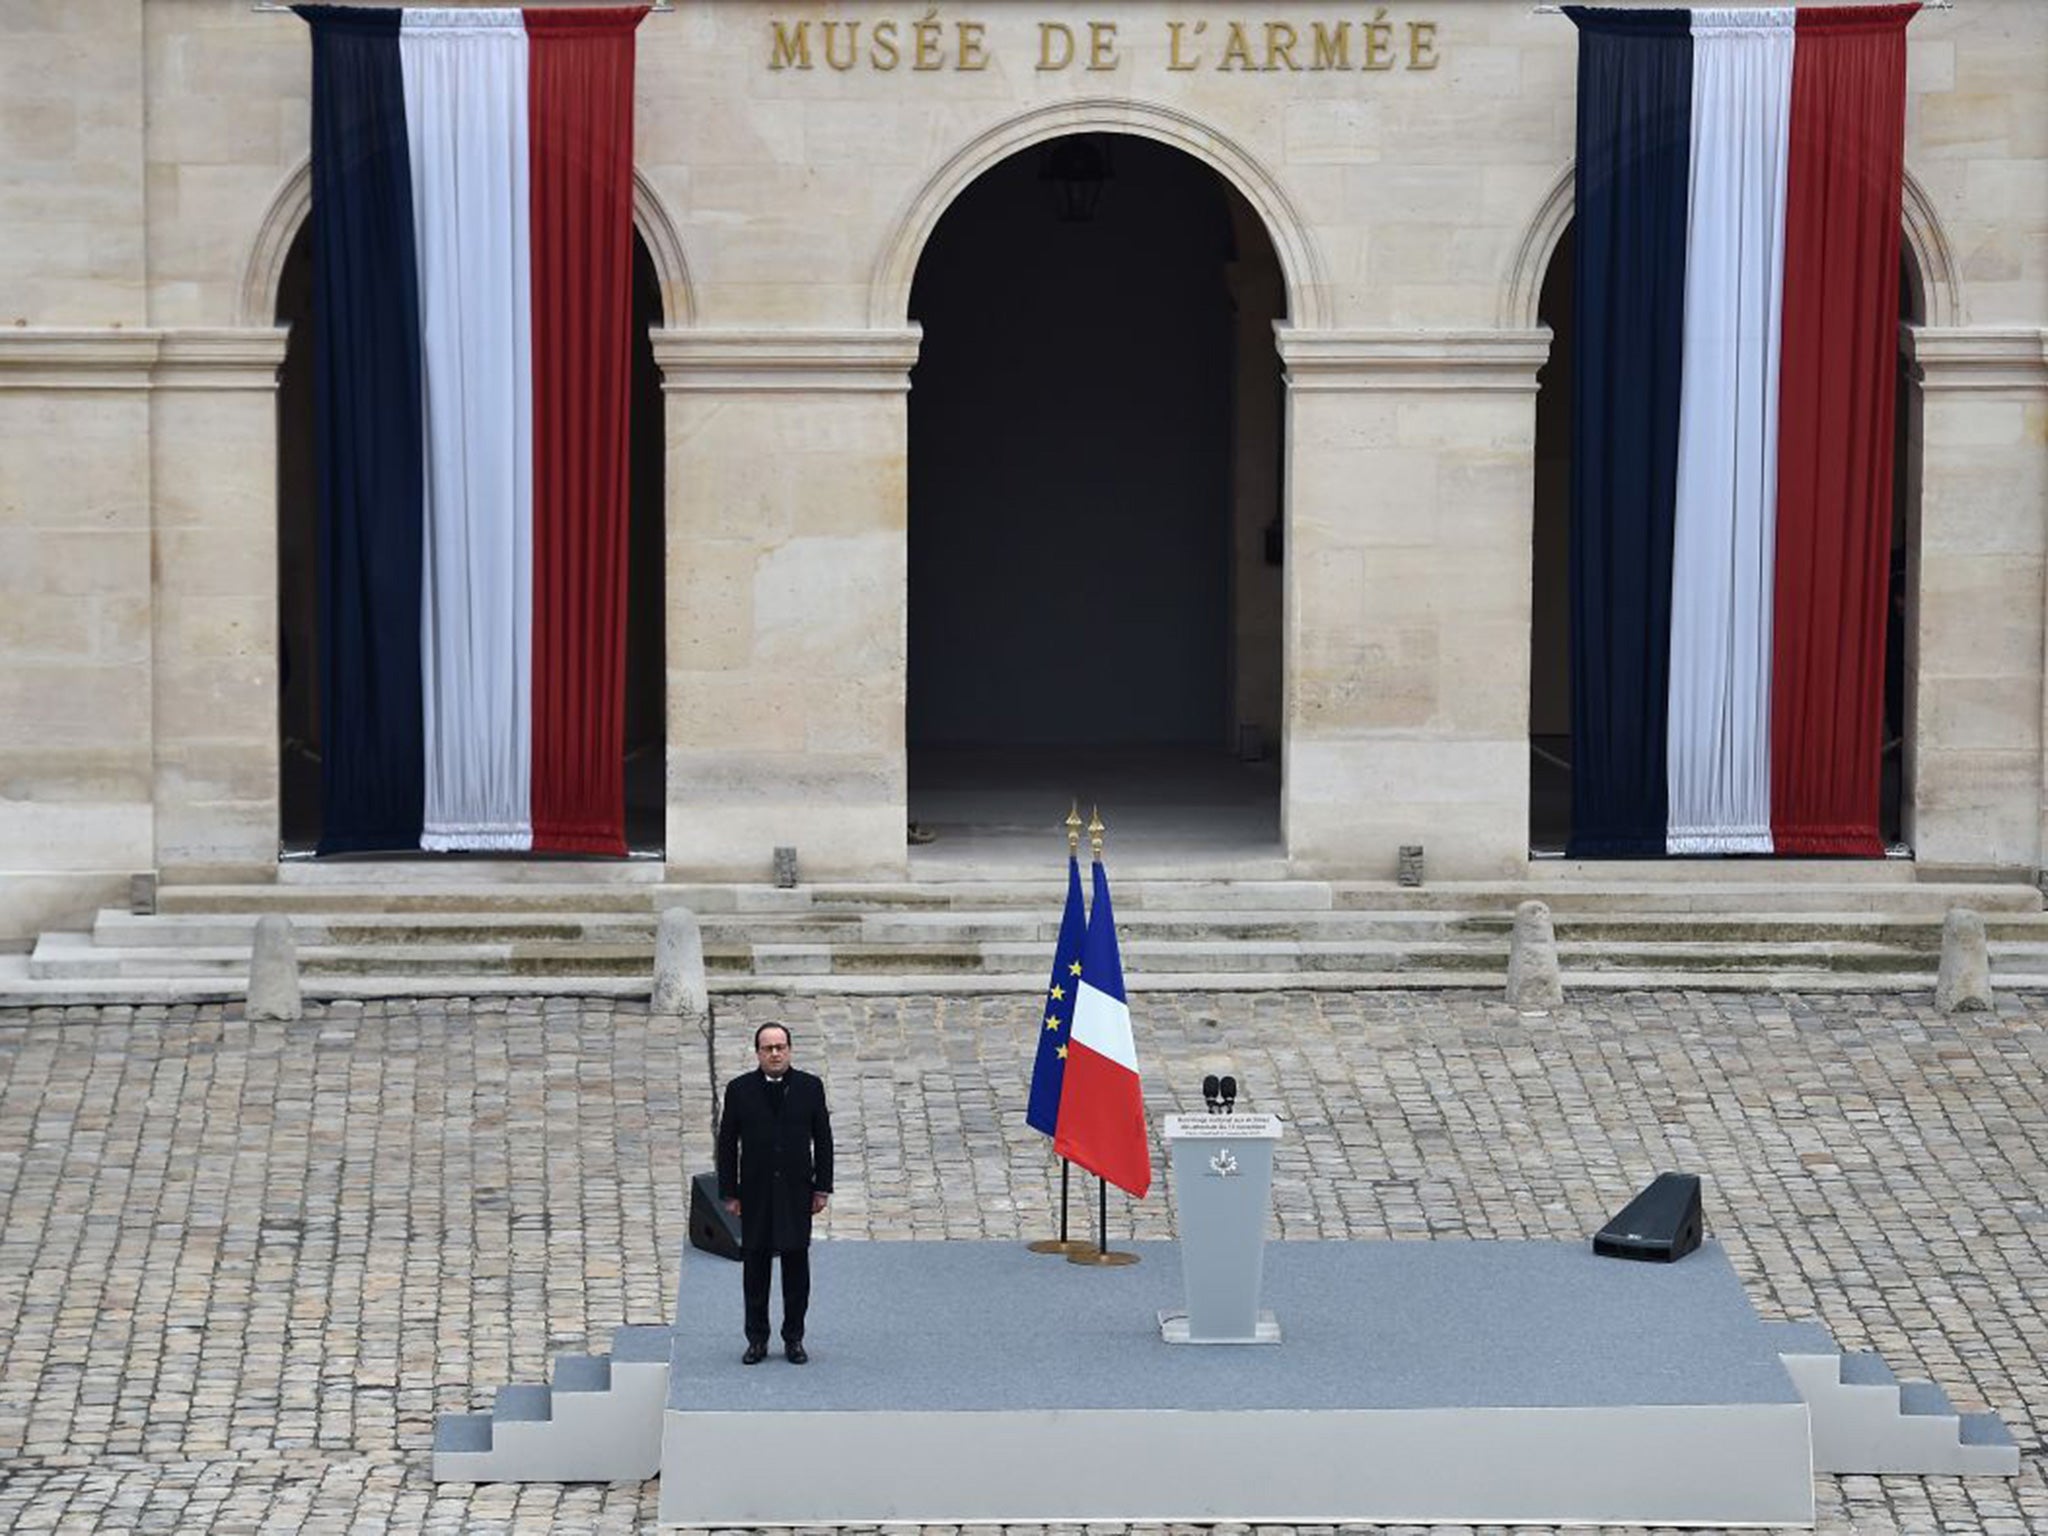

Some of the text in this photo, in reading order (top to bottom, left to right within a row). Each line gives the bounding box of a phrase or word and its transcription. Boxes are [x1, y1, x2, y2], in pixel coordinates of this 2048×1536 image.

[767, 7, 1440, 71] MUSÉE DE L'ARMÉE
